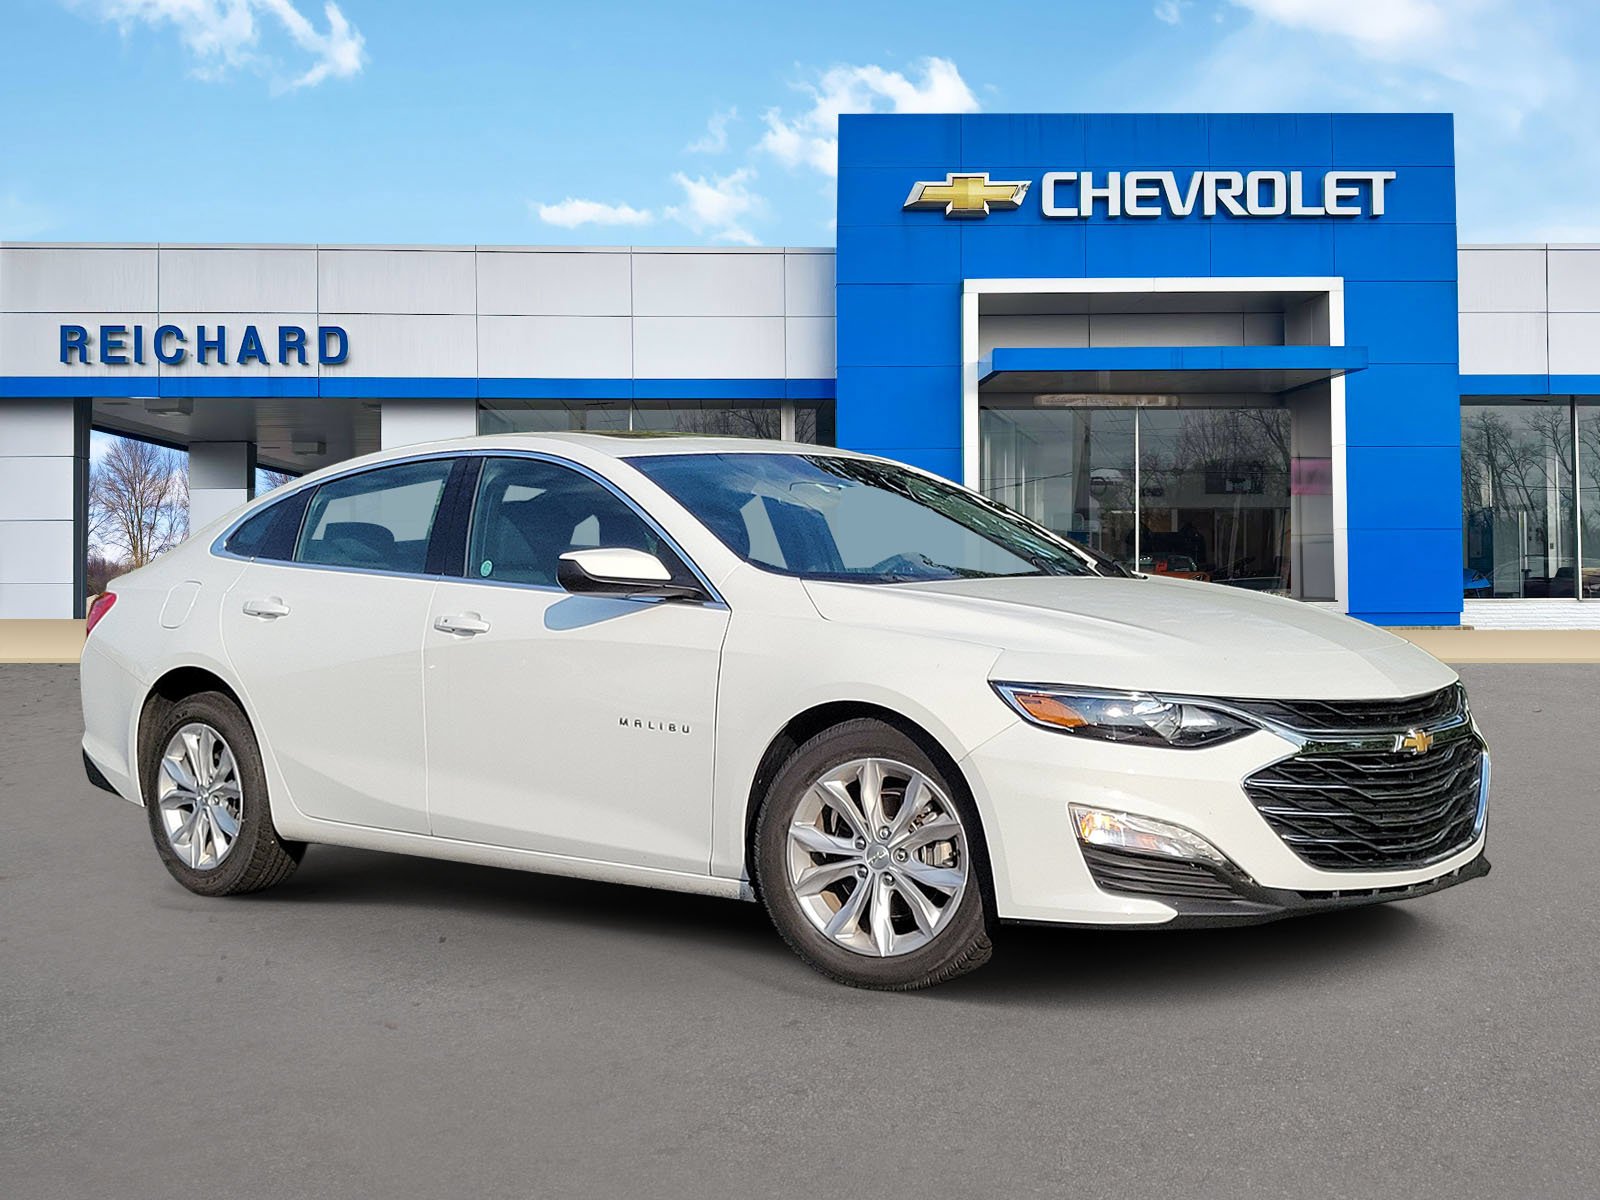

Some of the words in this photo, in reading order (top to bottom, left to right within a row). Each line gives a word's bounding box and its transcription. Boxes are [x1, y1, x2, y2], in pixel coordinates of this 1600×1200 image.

[1041, 170, 1396, 218] CHEVROLET
[60, 325, 350, 365] REICHARD
[619, 717, 690, 734] MALIBU
